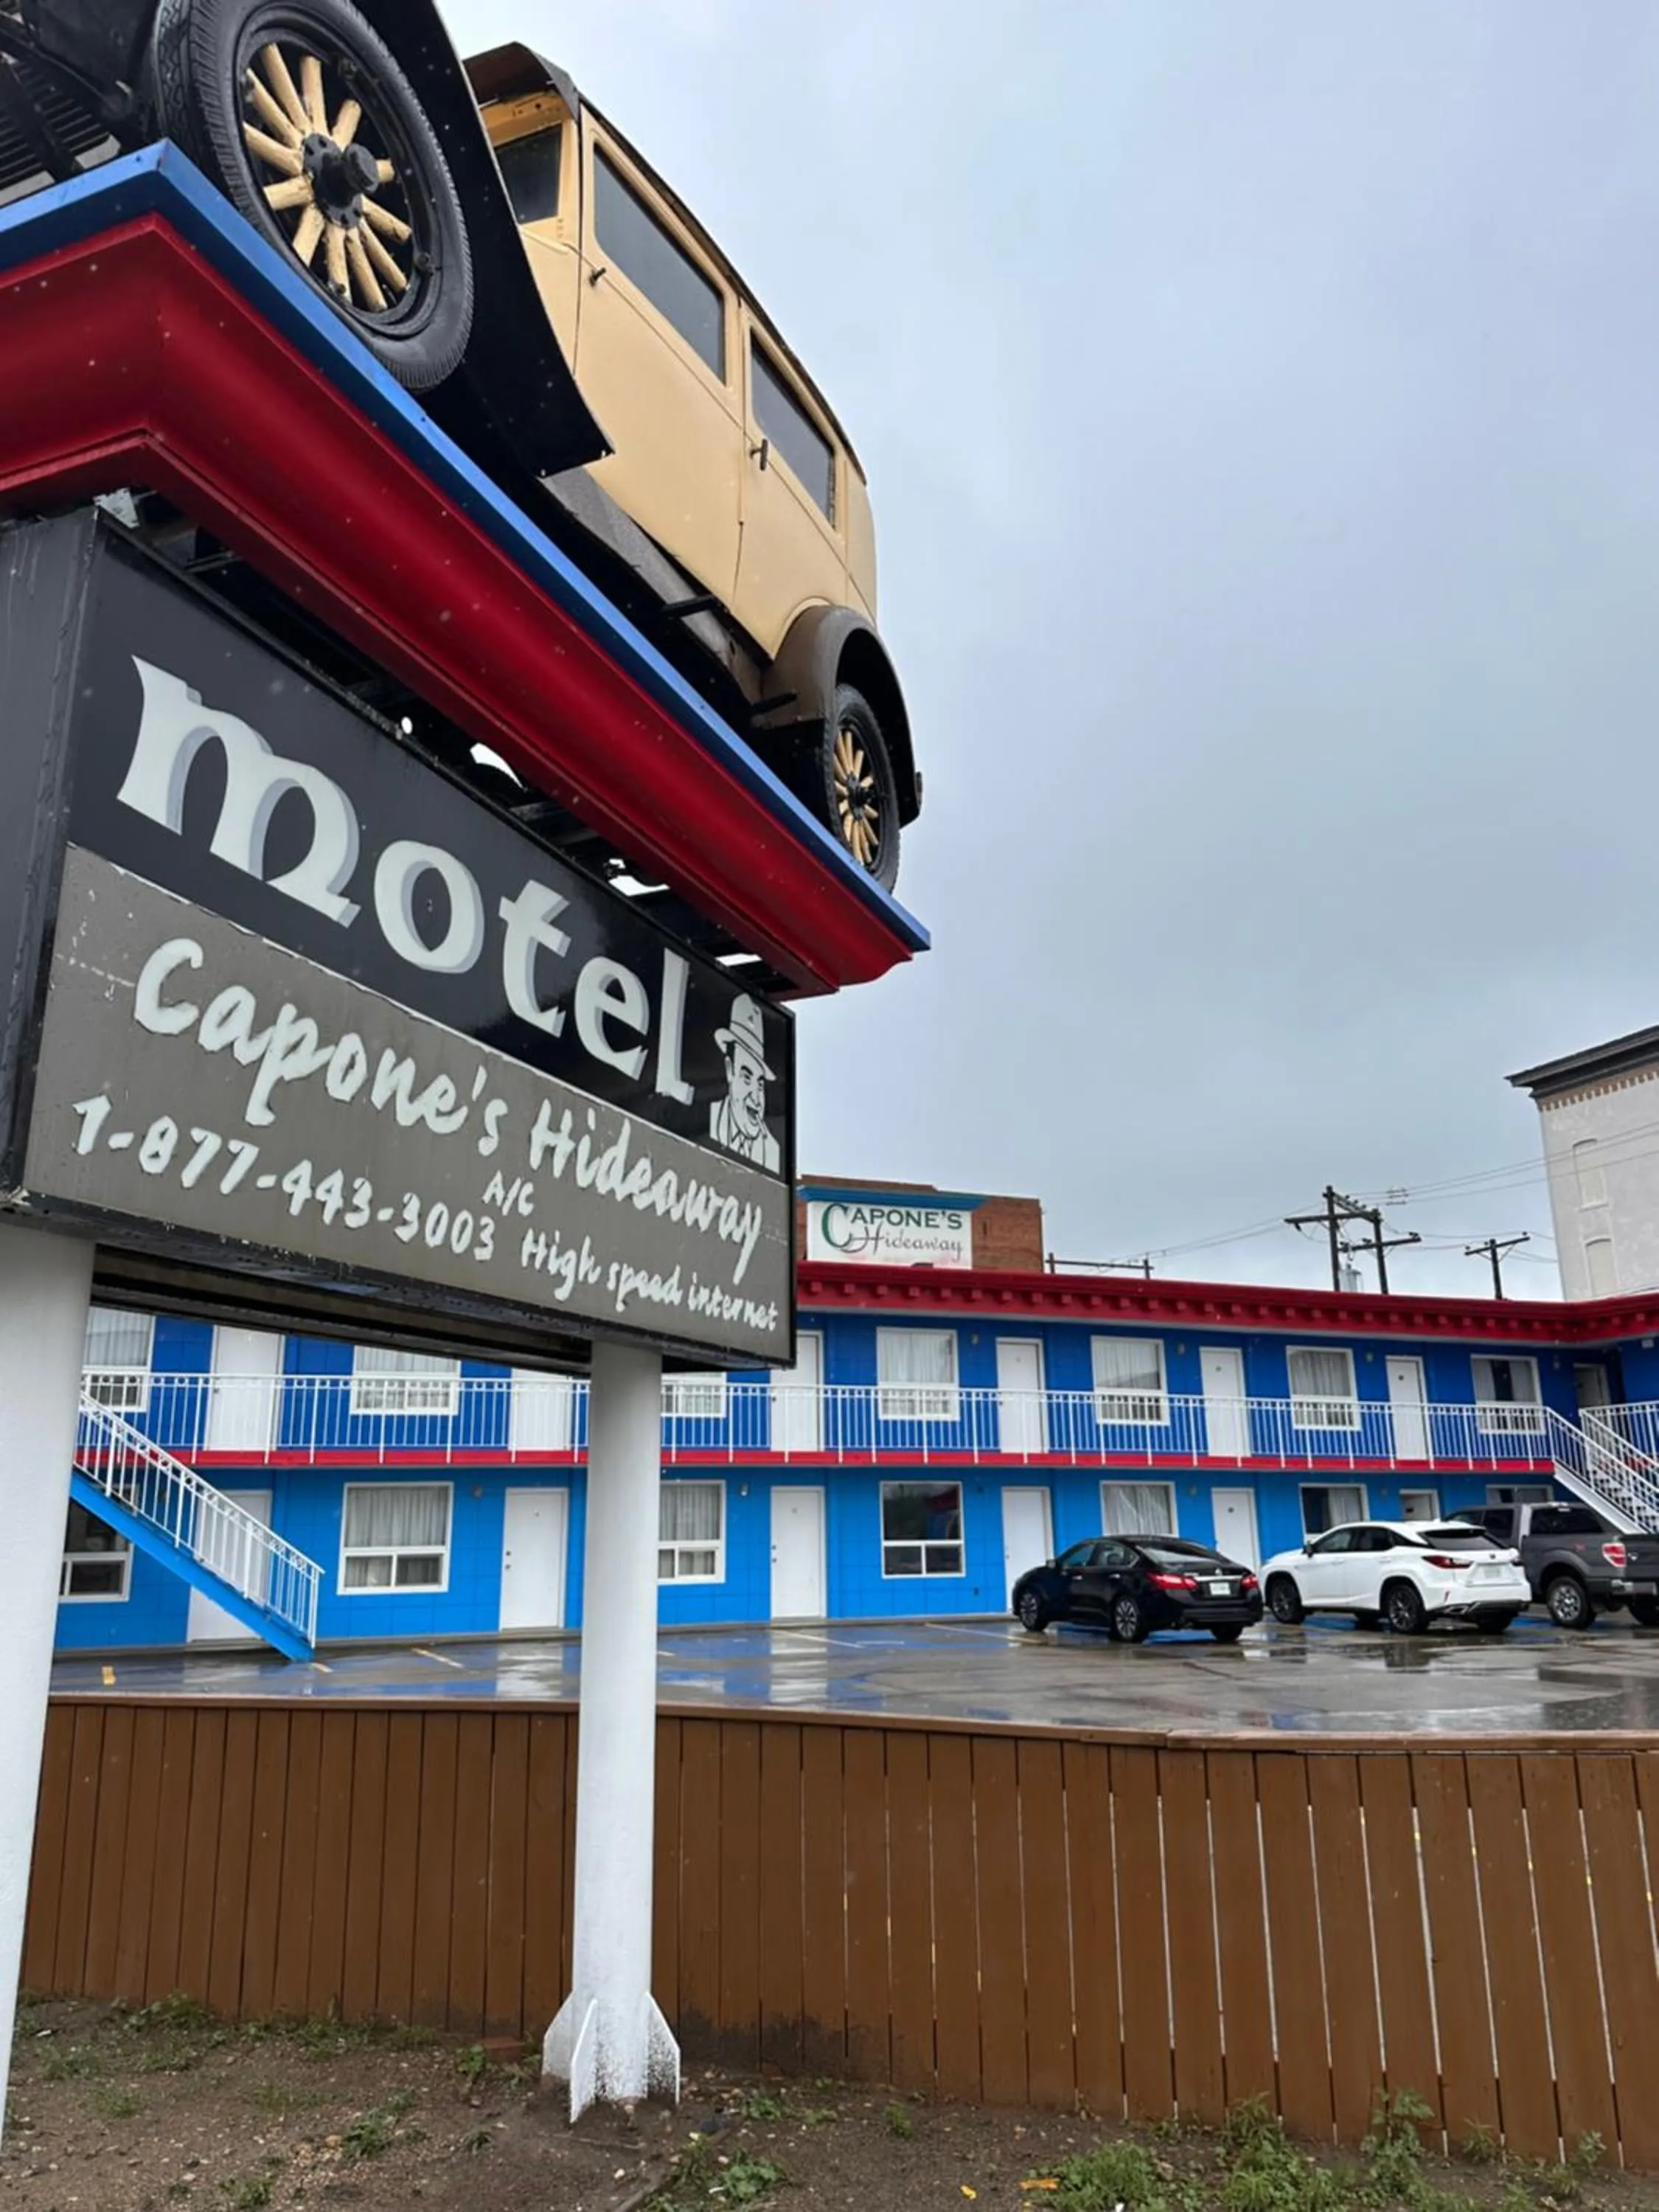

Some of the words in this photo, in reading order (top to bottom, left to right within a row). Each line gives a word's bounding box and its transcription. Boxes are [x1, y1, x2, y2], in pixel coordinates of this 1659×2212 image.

[116, 653, 695, 1107] motel
[133, 937, 509, 1156] Capone's
[529, 1099, 762, 1285] Hideaway
[72, 1095, 496, 1261] 1-877-443-3003
[482, 1169, 535, 1217] A/C
[821, 1203, 962, 1249] CAPONE'S
[521, 1228, 602, 1301] High
[606, 1262, 683, 1312] speed
[687, 1272, 779, 1331] internet
[840, 1220, 963, 1262] Hideaway
